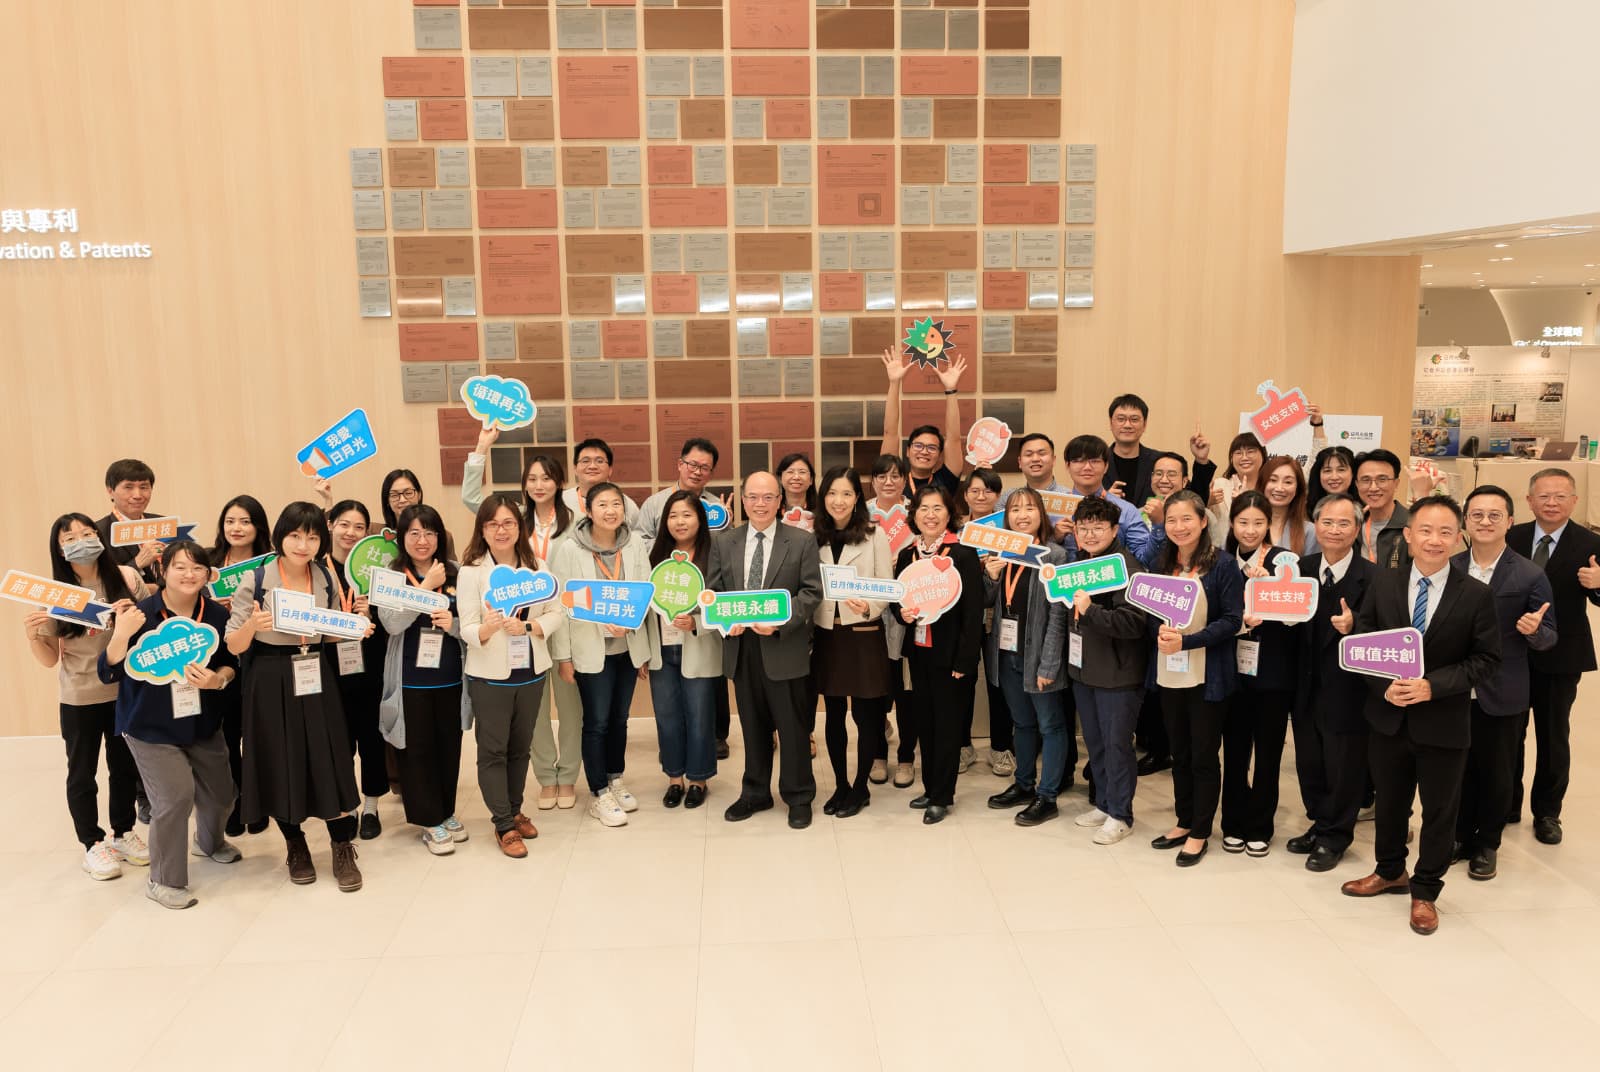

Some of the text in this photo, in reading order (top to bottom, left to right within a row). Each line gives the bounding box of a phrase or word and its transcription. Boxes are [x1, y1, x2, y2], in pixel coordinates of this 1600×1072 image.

[1, 209, 78, 233] 與專利
[59, 241, 75, 258] &
[80, 242, 152, 258] Patents
[472, 382, 528, 418] 循環再生
[1260, 402, 1299, 431] 女性支持
[324, 426, 353, 449] 我愛
[330, 436, 368, 466] 日月光
[119, 523, 172, 541] 前瞻科技
[970, 529, 1024, 551] 前瞻科技
[663, 571, 692, 587] 社會
[830, 580, 895, 593] 日月傳承永續創生
[1057, 565, 1116, 591] 環境永續
[10, 579, 82, 608] 前瞻科技
[376, 584, 439, 607] 日月傳承永續創生
[492, 577, 548, 603] 低碳使命
[601, 585, 631, 601] 我愛
[660, 590, 689, 606] 共融
[1135, 582, 1191, 612] 價值共創
[1258, 590, 1306, 604] 女性支持
[281, 608, 358, 630] 日月傳承永續創生
[593, 602, 636, 618] 日月光
[716, 599, 780, 618] 環境永續
[136, 633, 209, 669] 循環再生
[1349, 646, 1416, 664] 價值共創
